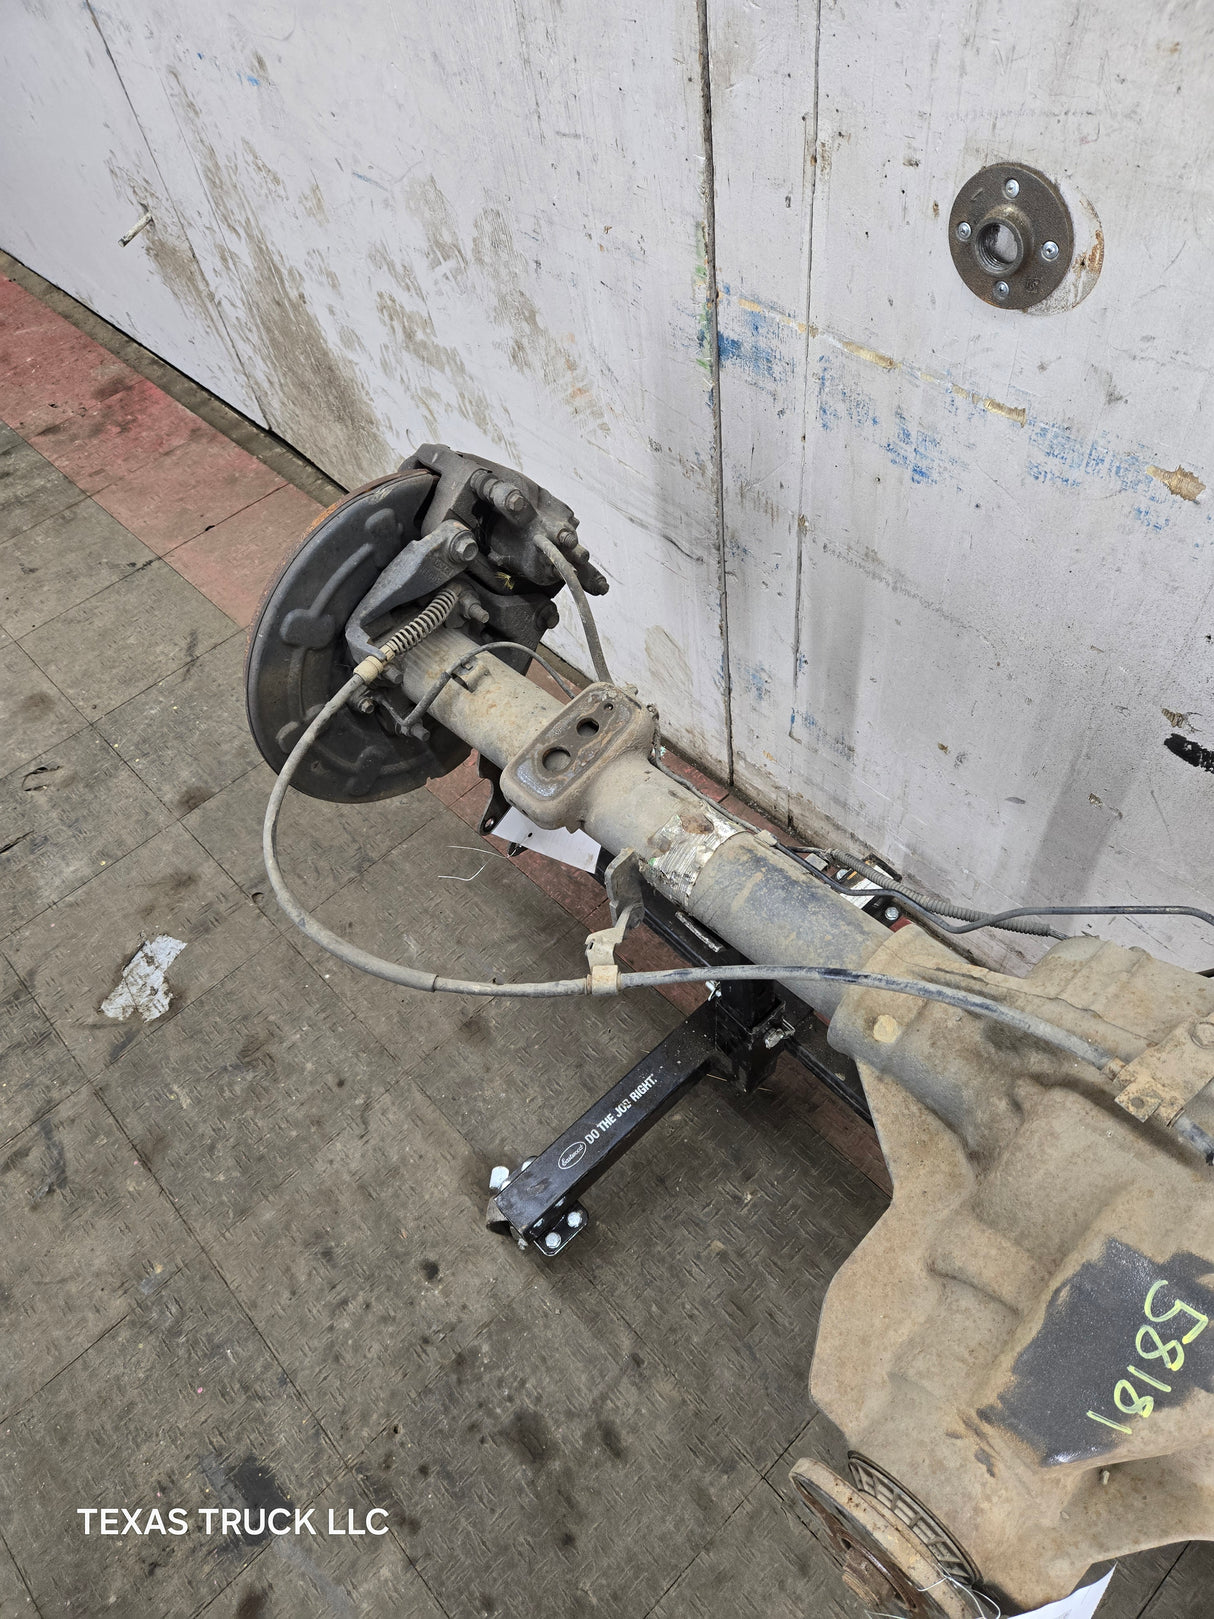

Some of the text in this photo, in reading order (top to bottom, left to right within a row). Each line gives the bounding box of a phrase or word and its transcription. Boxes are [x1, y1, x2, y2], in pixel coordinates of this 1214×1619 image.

[584, 1129, 600, 1145] DO
[597, 1112, 617, 1132] THE
[1086, 1279, 1208, 1434] 58181
